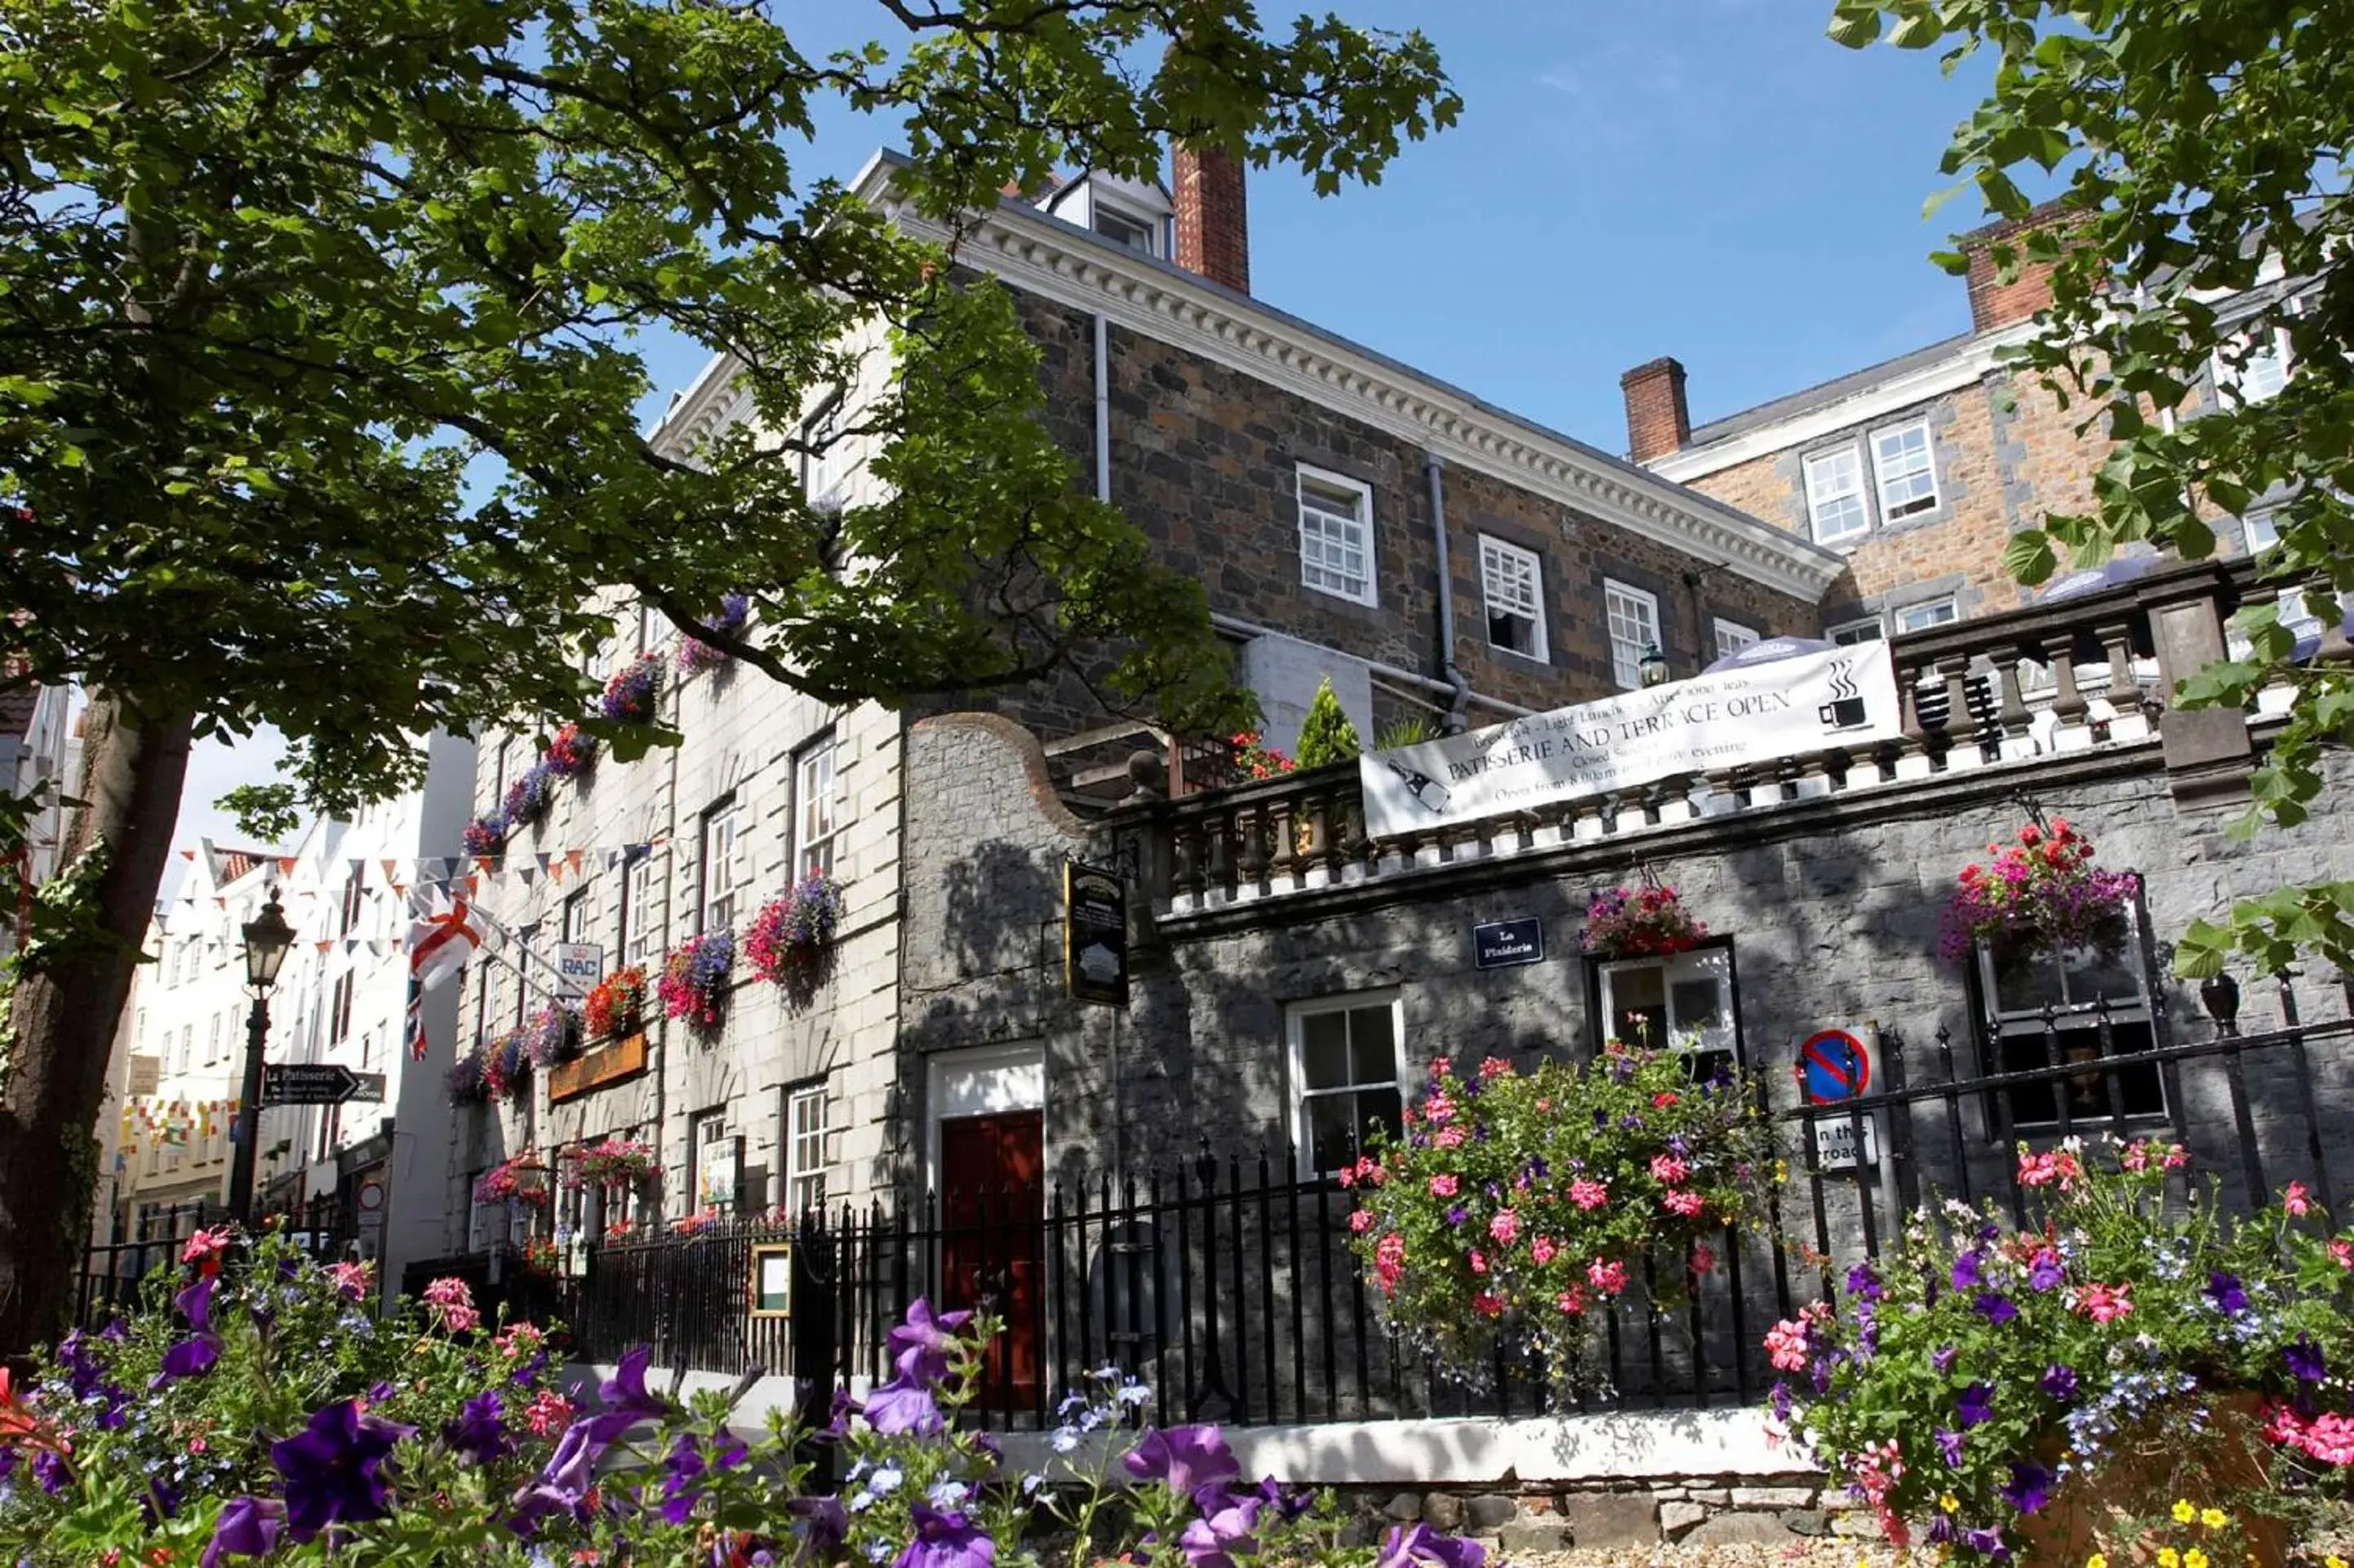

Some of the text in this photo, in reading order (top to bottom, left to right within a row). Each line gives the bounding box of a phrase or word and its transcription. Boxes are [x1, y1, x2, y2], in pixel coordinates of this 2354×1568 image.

[1544, 715, 1575, 732] Light
[1448, 740, 1554, 780] PATISSERIE
[1561, 727, 1611, 754] AND
[1617, 702, 1721, 740] TERRACE
[1727, 689, 1791, 718] OPEN
[1572, 750, 1610, 769] Closed
[1499, 931, 1515, 941] La
[562, 958, 597, 976] RAC
[267, 1069, 335, 1082] La Patisserie
